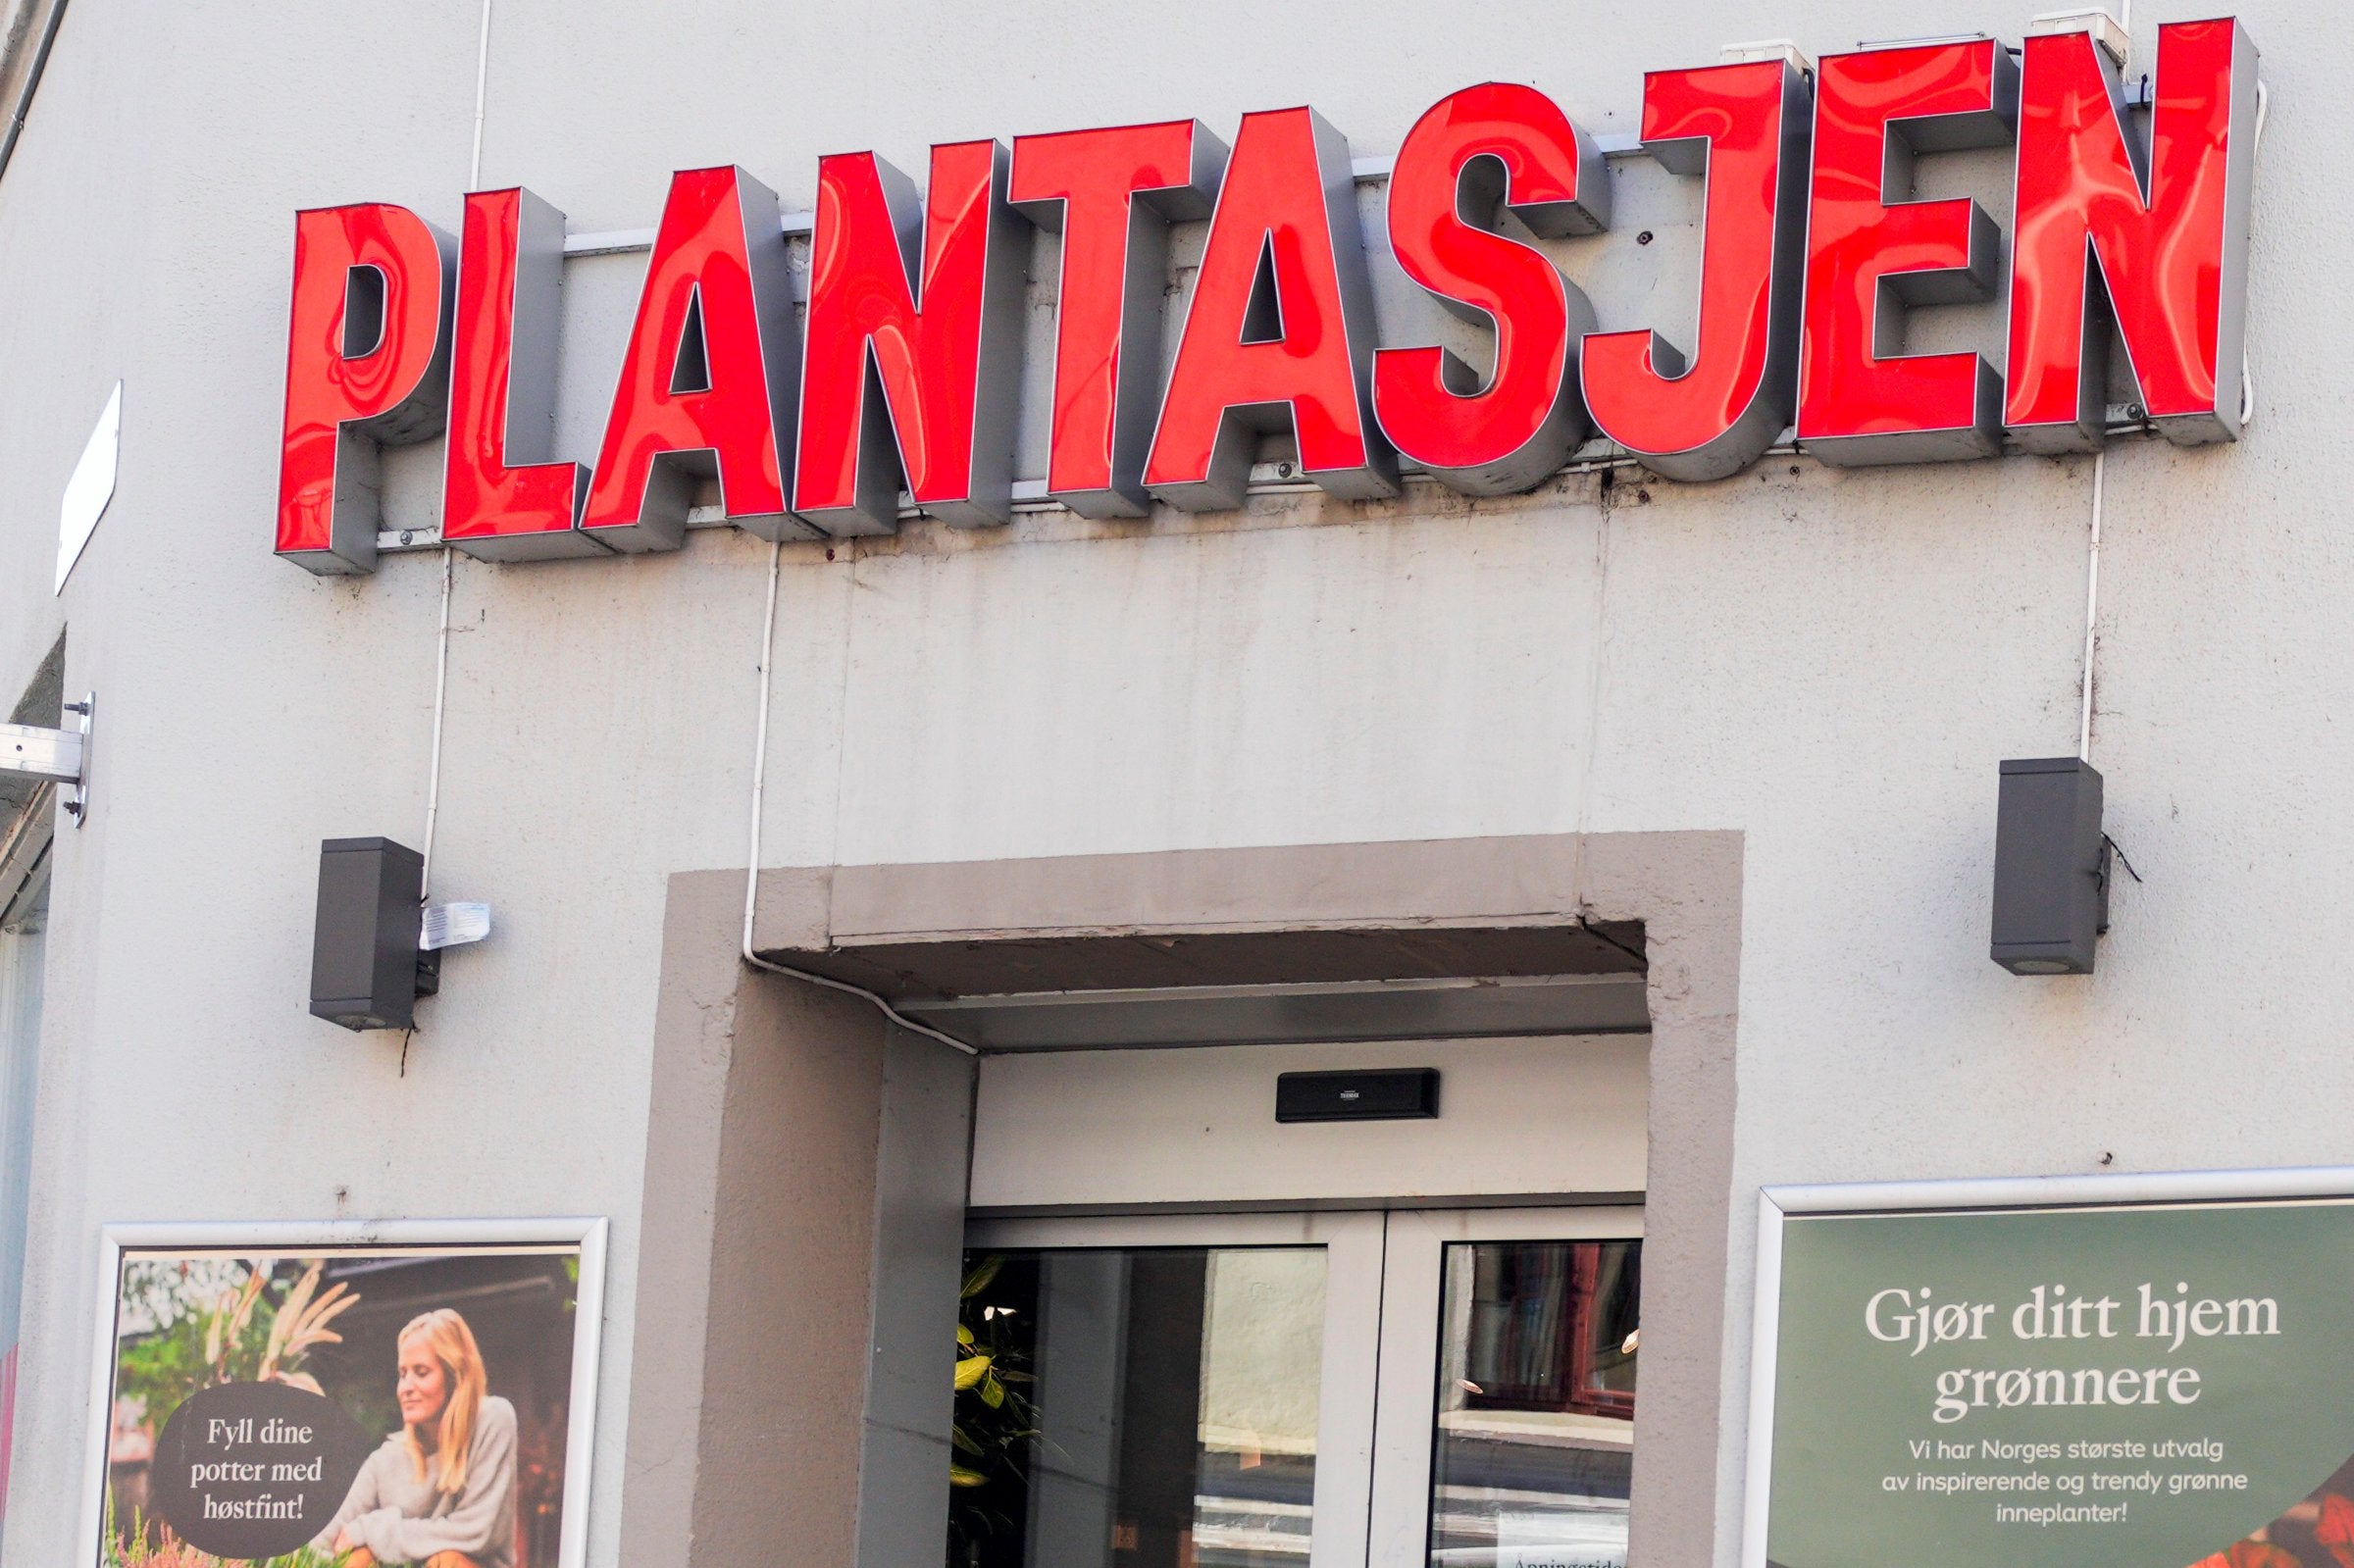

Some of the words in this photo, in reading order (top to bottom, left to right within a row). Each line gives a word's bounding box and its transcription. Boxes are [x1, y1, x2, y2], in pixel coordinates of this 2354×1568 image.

[275, 16, 2246, 561] PLANTASJEN
[1865, 1287, 1995, 1357] Gjør
[2012, 1284, 2122, 1340] ditt
[2135, 1282, 2281, 1353] hjem
[1932, 1367, 2201, 1424] grønnere
[207, 1418, 253, 1451] Fyll
[259, 1418, 313, 1444] dine
[1909, 1440, 1930, 1459] Vi
[1937, 1440, 1975, 1460] har
[1981, 1439, 2062, 1464] Norges
[2068, 1440, 2146, 1459] største
[2152, 1437, 2224, 1463] utvalg
[189, 1461, 266, 1489] potter
[271, 1455, 323, 1482] med
[1881, 1476, 1910, 1492] av
[1917, 1471, 2050, 1495] inspirerende
[2056, 1475, 2084, 1495] og
[2091, 1470, 2164, 1494] trendy
[2169, 1474, 2248, 1495] grønne
[203, 1492, 304, 1520] høstfint!
[1996, 1501, 2127, 1528] inneplanter!
